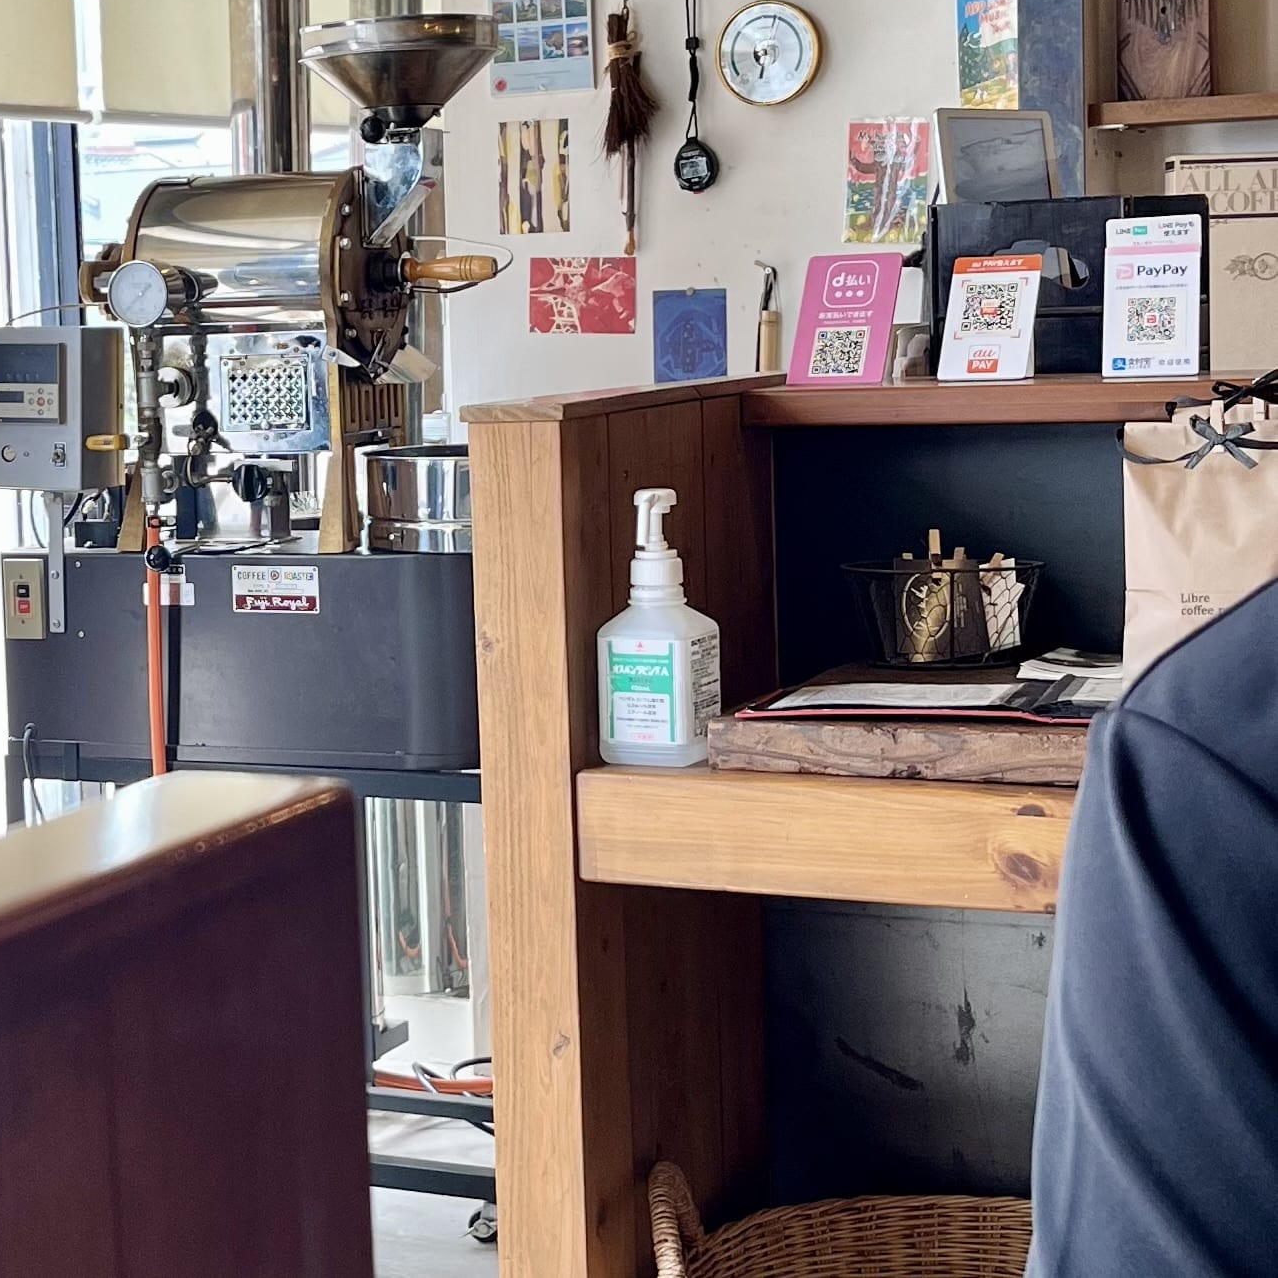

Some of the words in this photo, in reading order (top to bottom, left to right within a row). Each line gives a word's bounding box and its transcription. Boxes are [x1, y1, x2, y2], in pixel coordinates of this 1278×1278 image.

[1137, 264, 1188, 277] PayPay
[832, 272, 871, 287] d払い
[972, 360, 994, 370] PAY
[237, 571, 266, 581] COFFEE
[242, 596, 270, 610] Fuji
[272, 596, 310, 611] Royal
[1180, 593, 1211, 604] Libre
[1181, 605, 1215, 616] coffee
